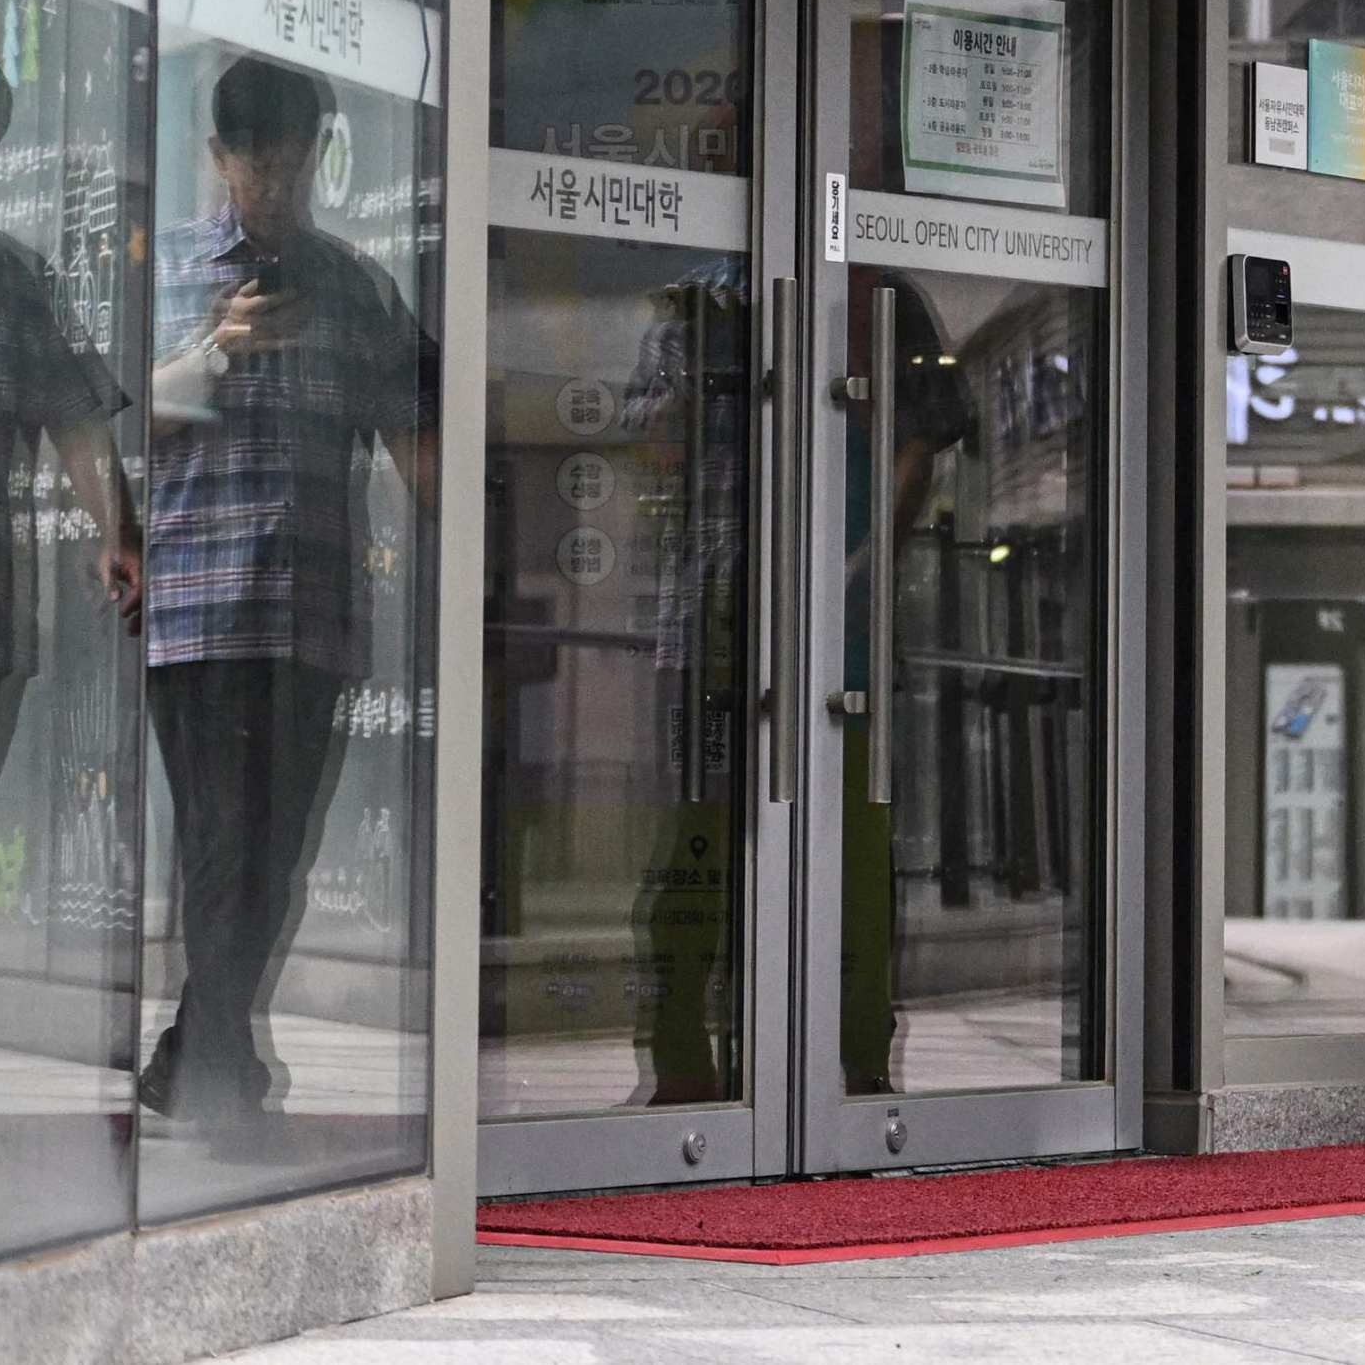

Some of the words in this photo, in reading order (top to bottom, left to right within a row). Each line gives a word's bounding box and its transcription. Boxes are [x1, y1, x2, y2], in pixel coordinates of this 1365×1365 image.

[953, 29, 993, 54] 이용시간
[996, 34, 1017, 57] 안내
[530, 166, 684, 233] 서울시민대학
[855, 213, 909, 244] SEOUL
[915, 220, 959, 249] OPEN
[964, 226, 1002, 254] CITY
[1005, 231, 1093, 265] UNIVERSITY
